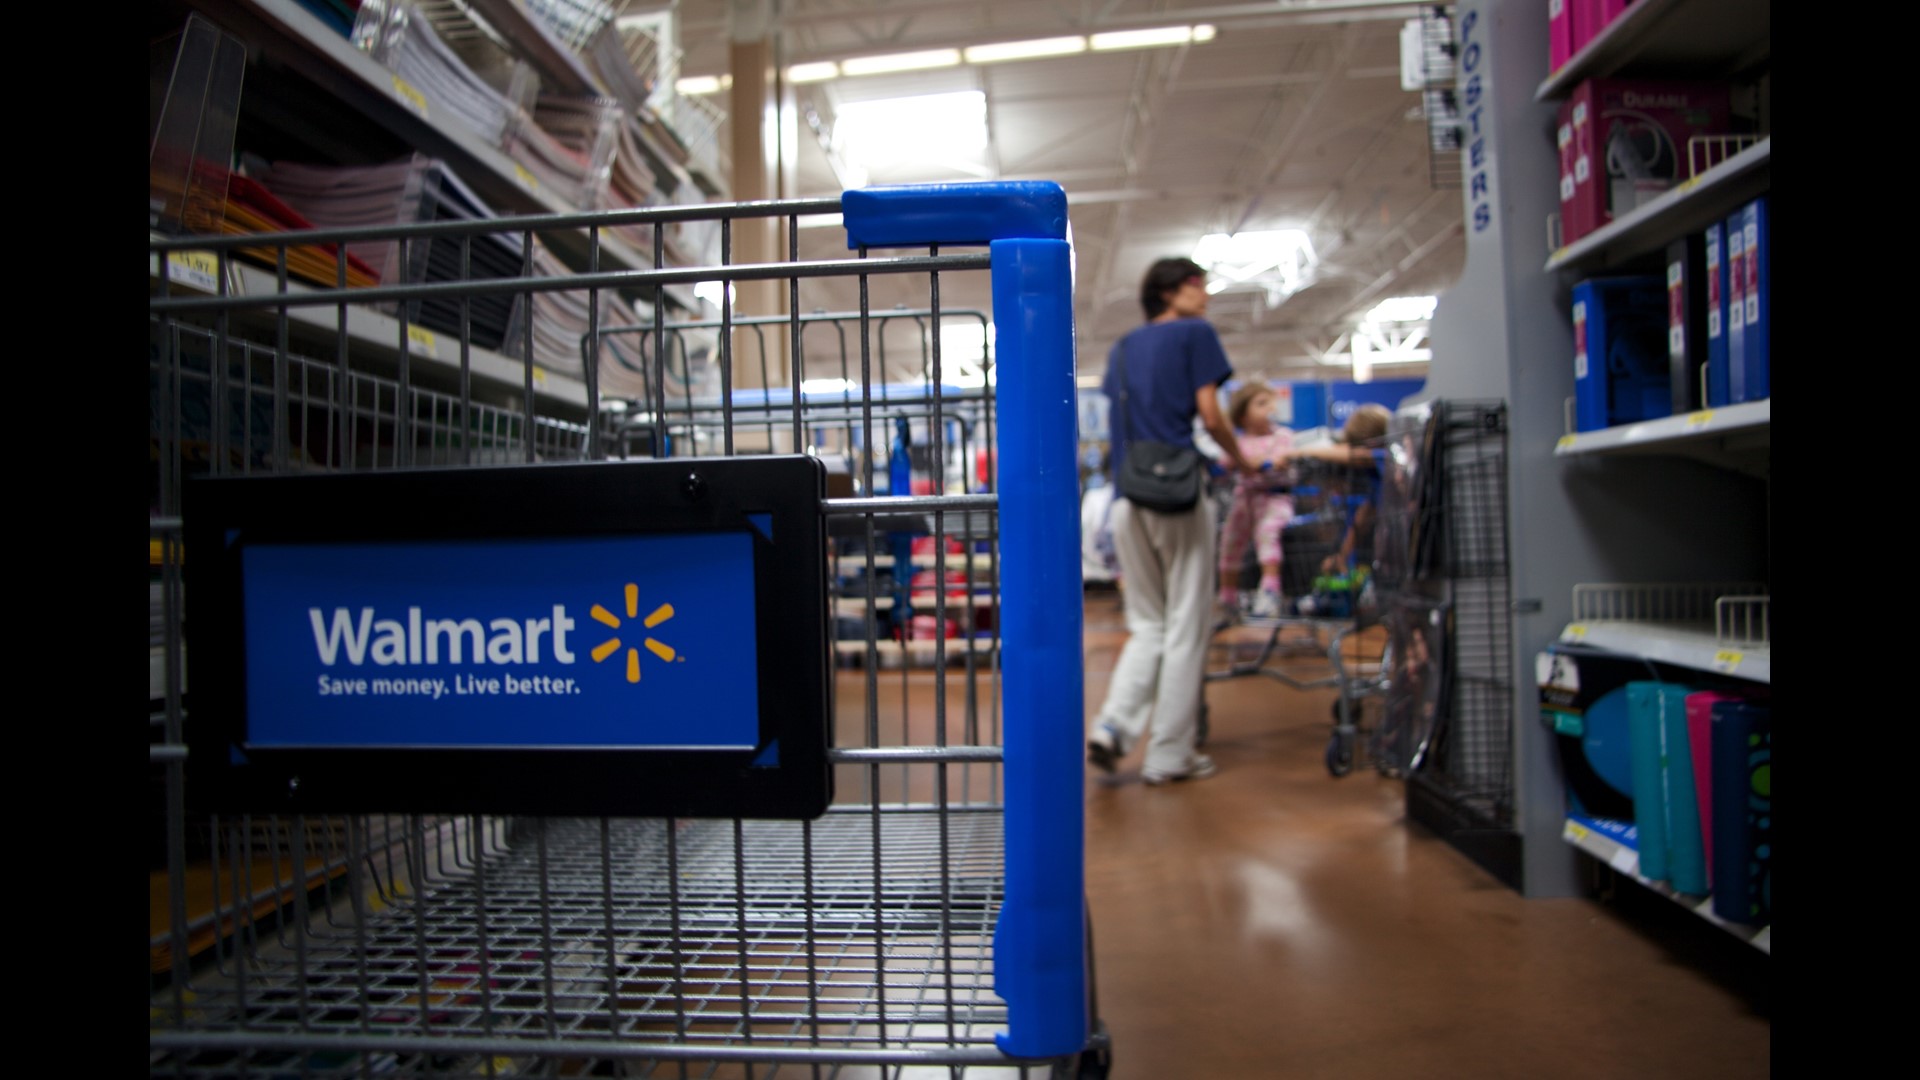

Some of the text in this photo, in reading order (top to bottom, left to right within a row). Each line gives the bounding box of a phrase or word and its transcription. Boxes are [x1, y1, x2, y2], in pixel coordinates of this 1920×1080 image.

[1461, 9, 1490, 232] POSTERS
[310, 605, 575, 666] Walmart
[318, 673, 581, 700] Save money. Live better.
